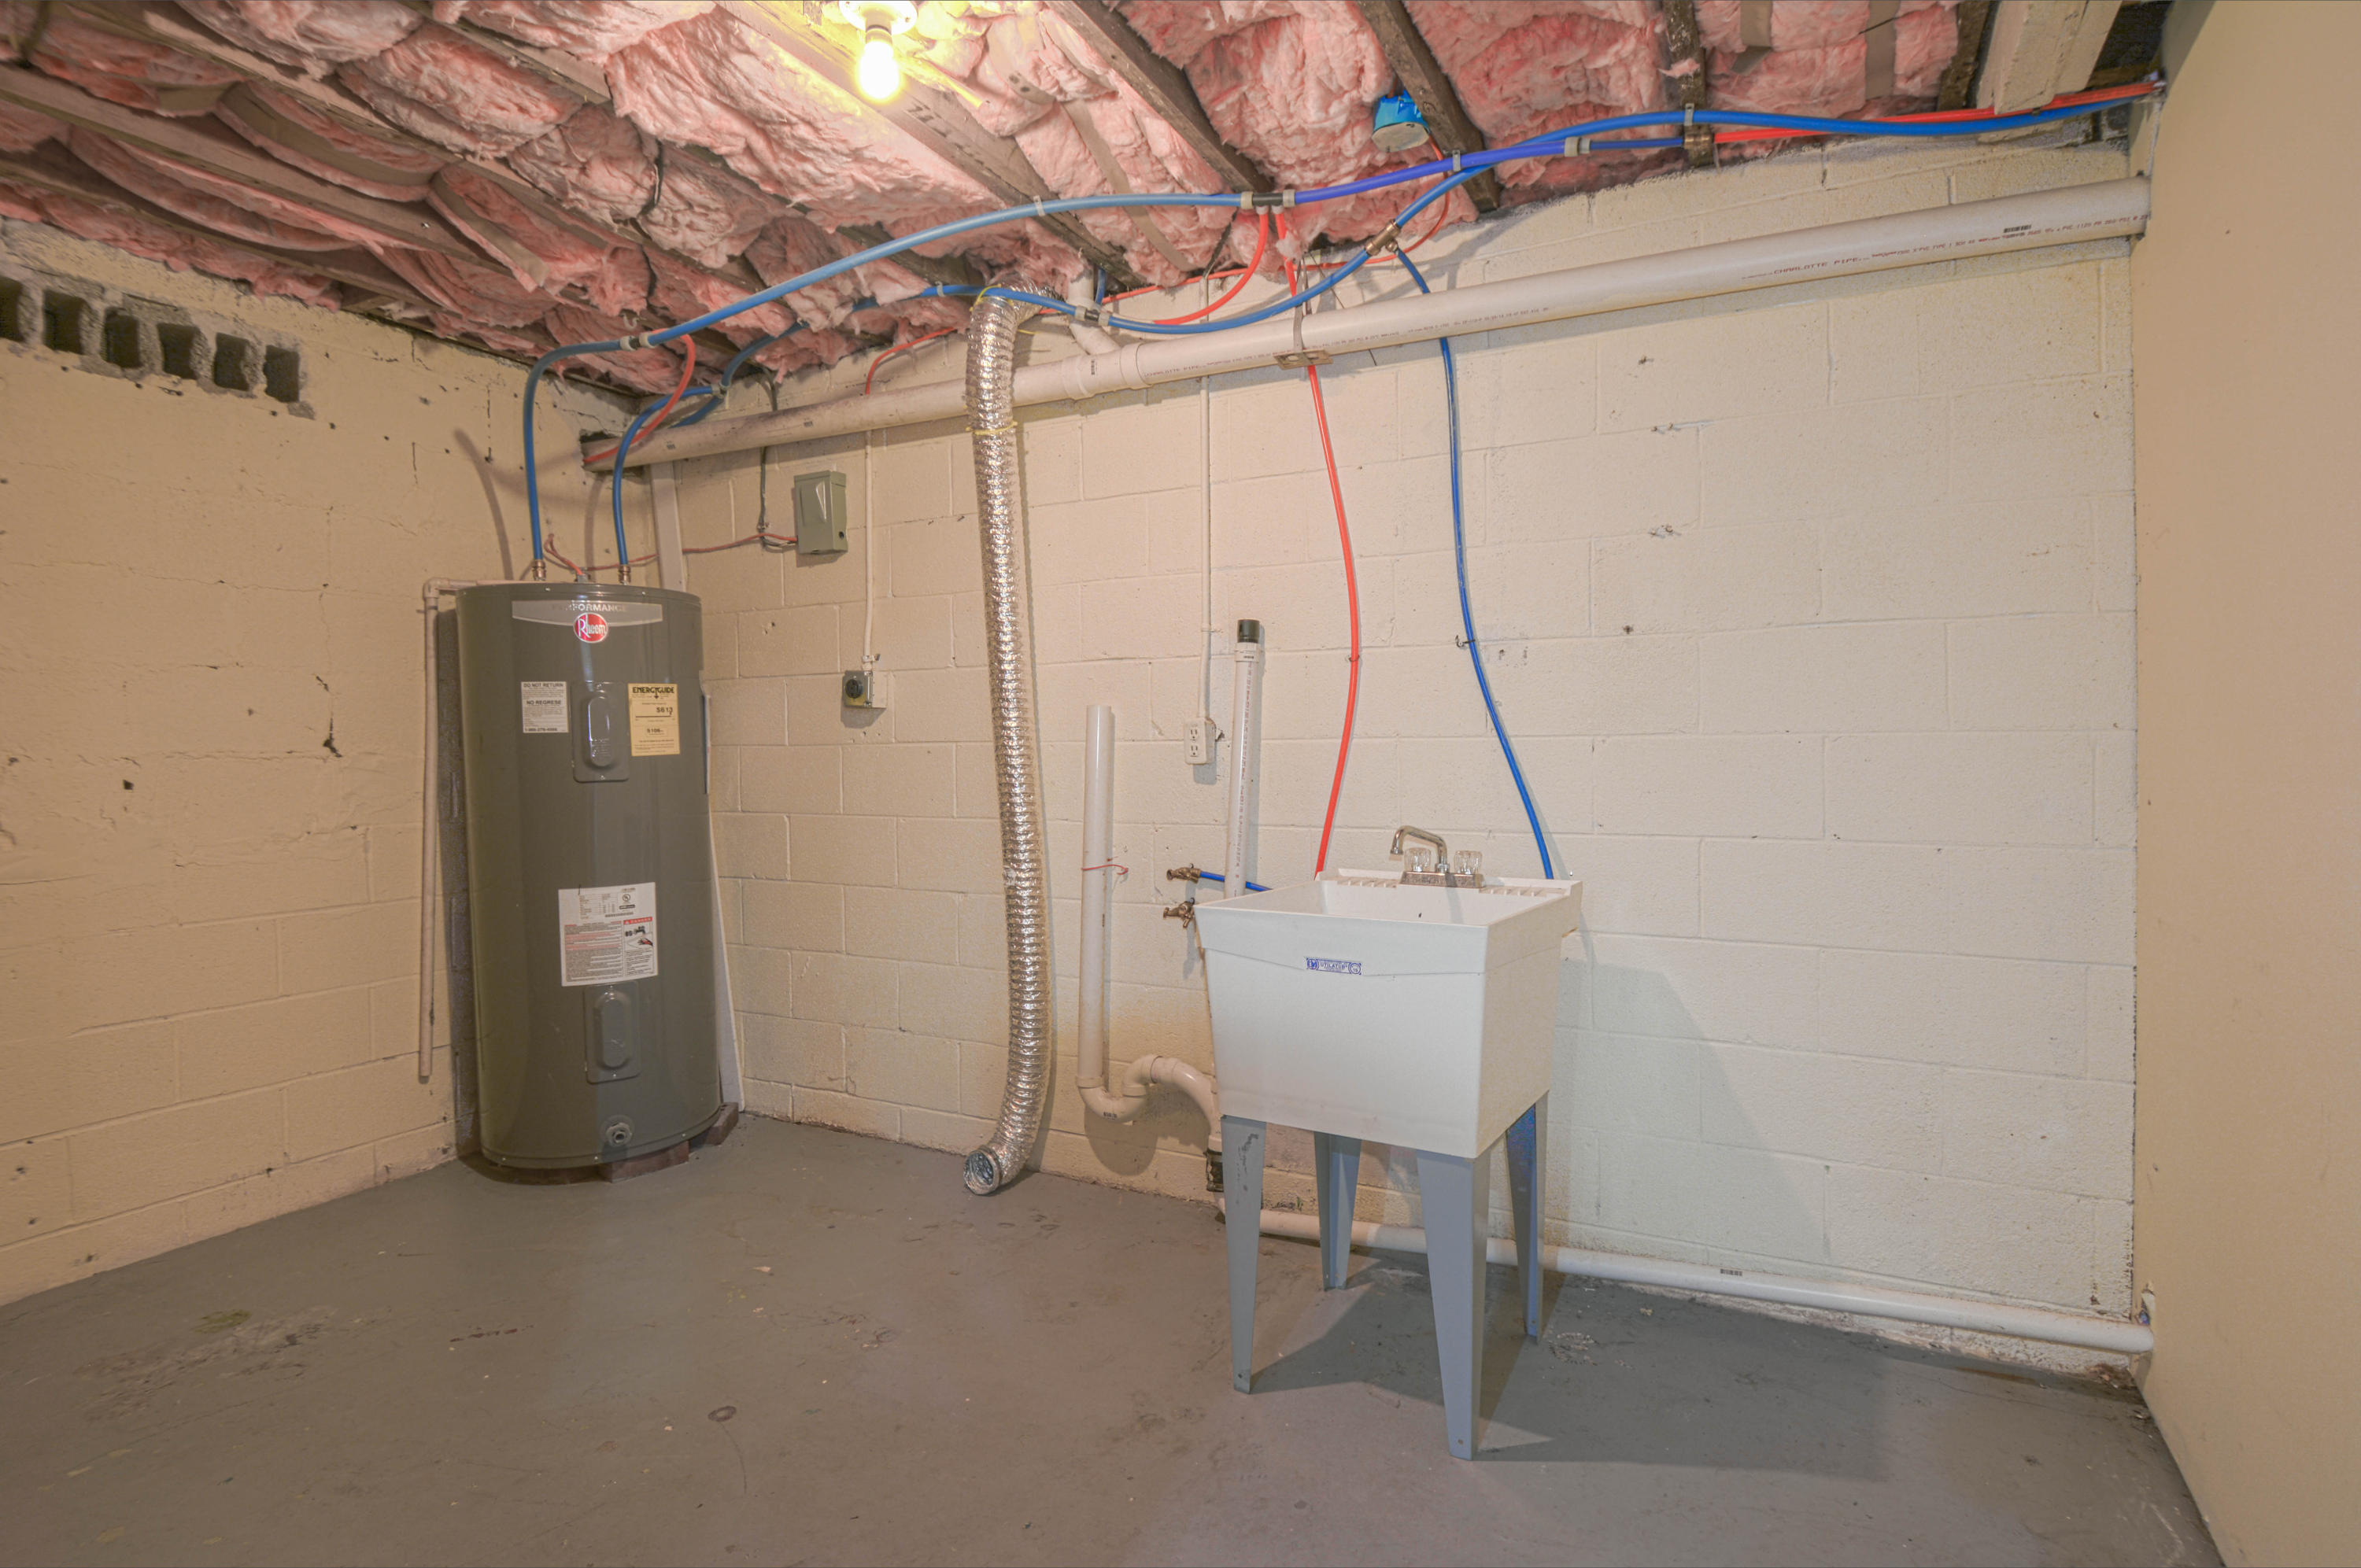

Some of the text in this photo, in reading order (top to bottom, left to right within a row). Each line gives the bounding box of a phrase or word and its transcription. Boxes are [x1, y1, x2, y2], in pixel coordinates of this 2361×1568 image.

[1774, 262, 1827, 275] CHARLOTTE
[1834, 256, 1859, 265] PIPE
[552, 603, 627, 612] FORMANCE
[577, 613, 607, 638] Rheem
